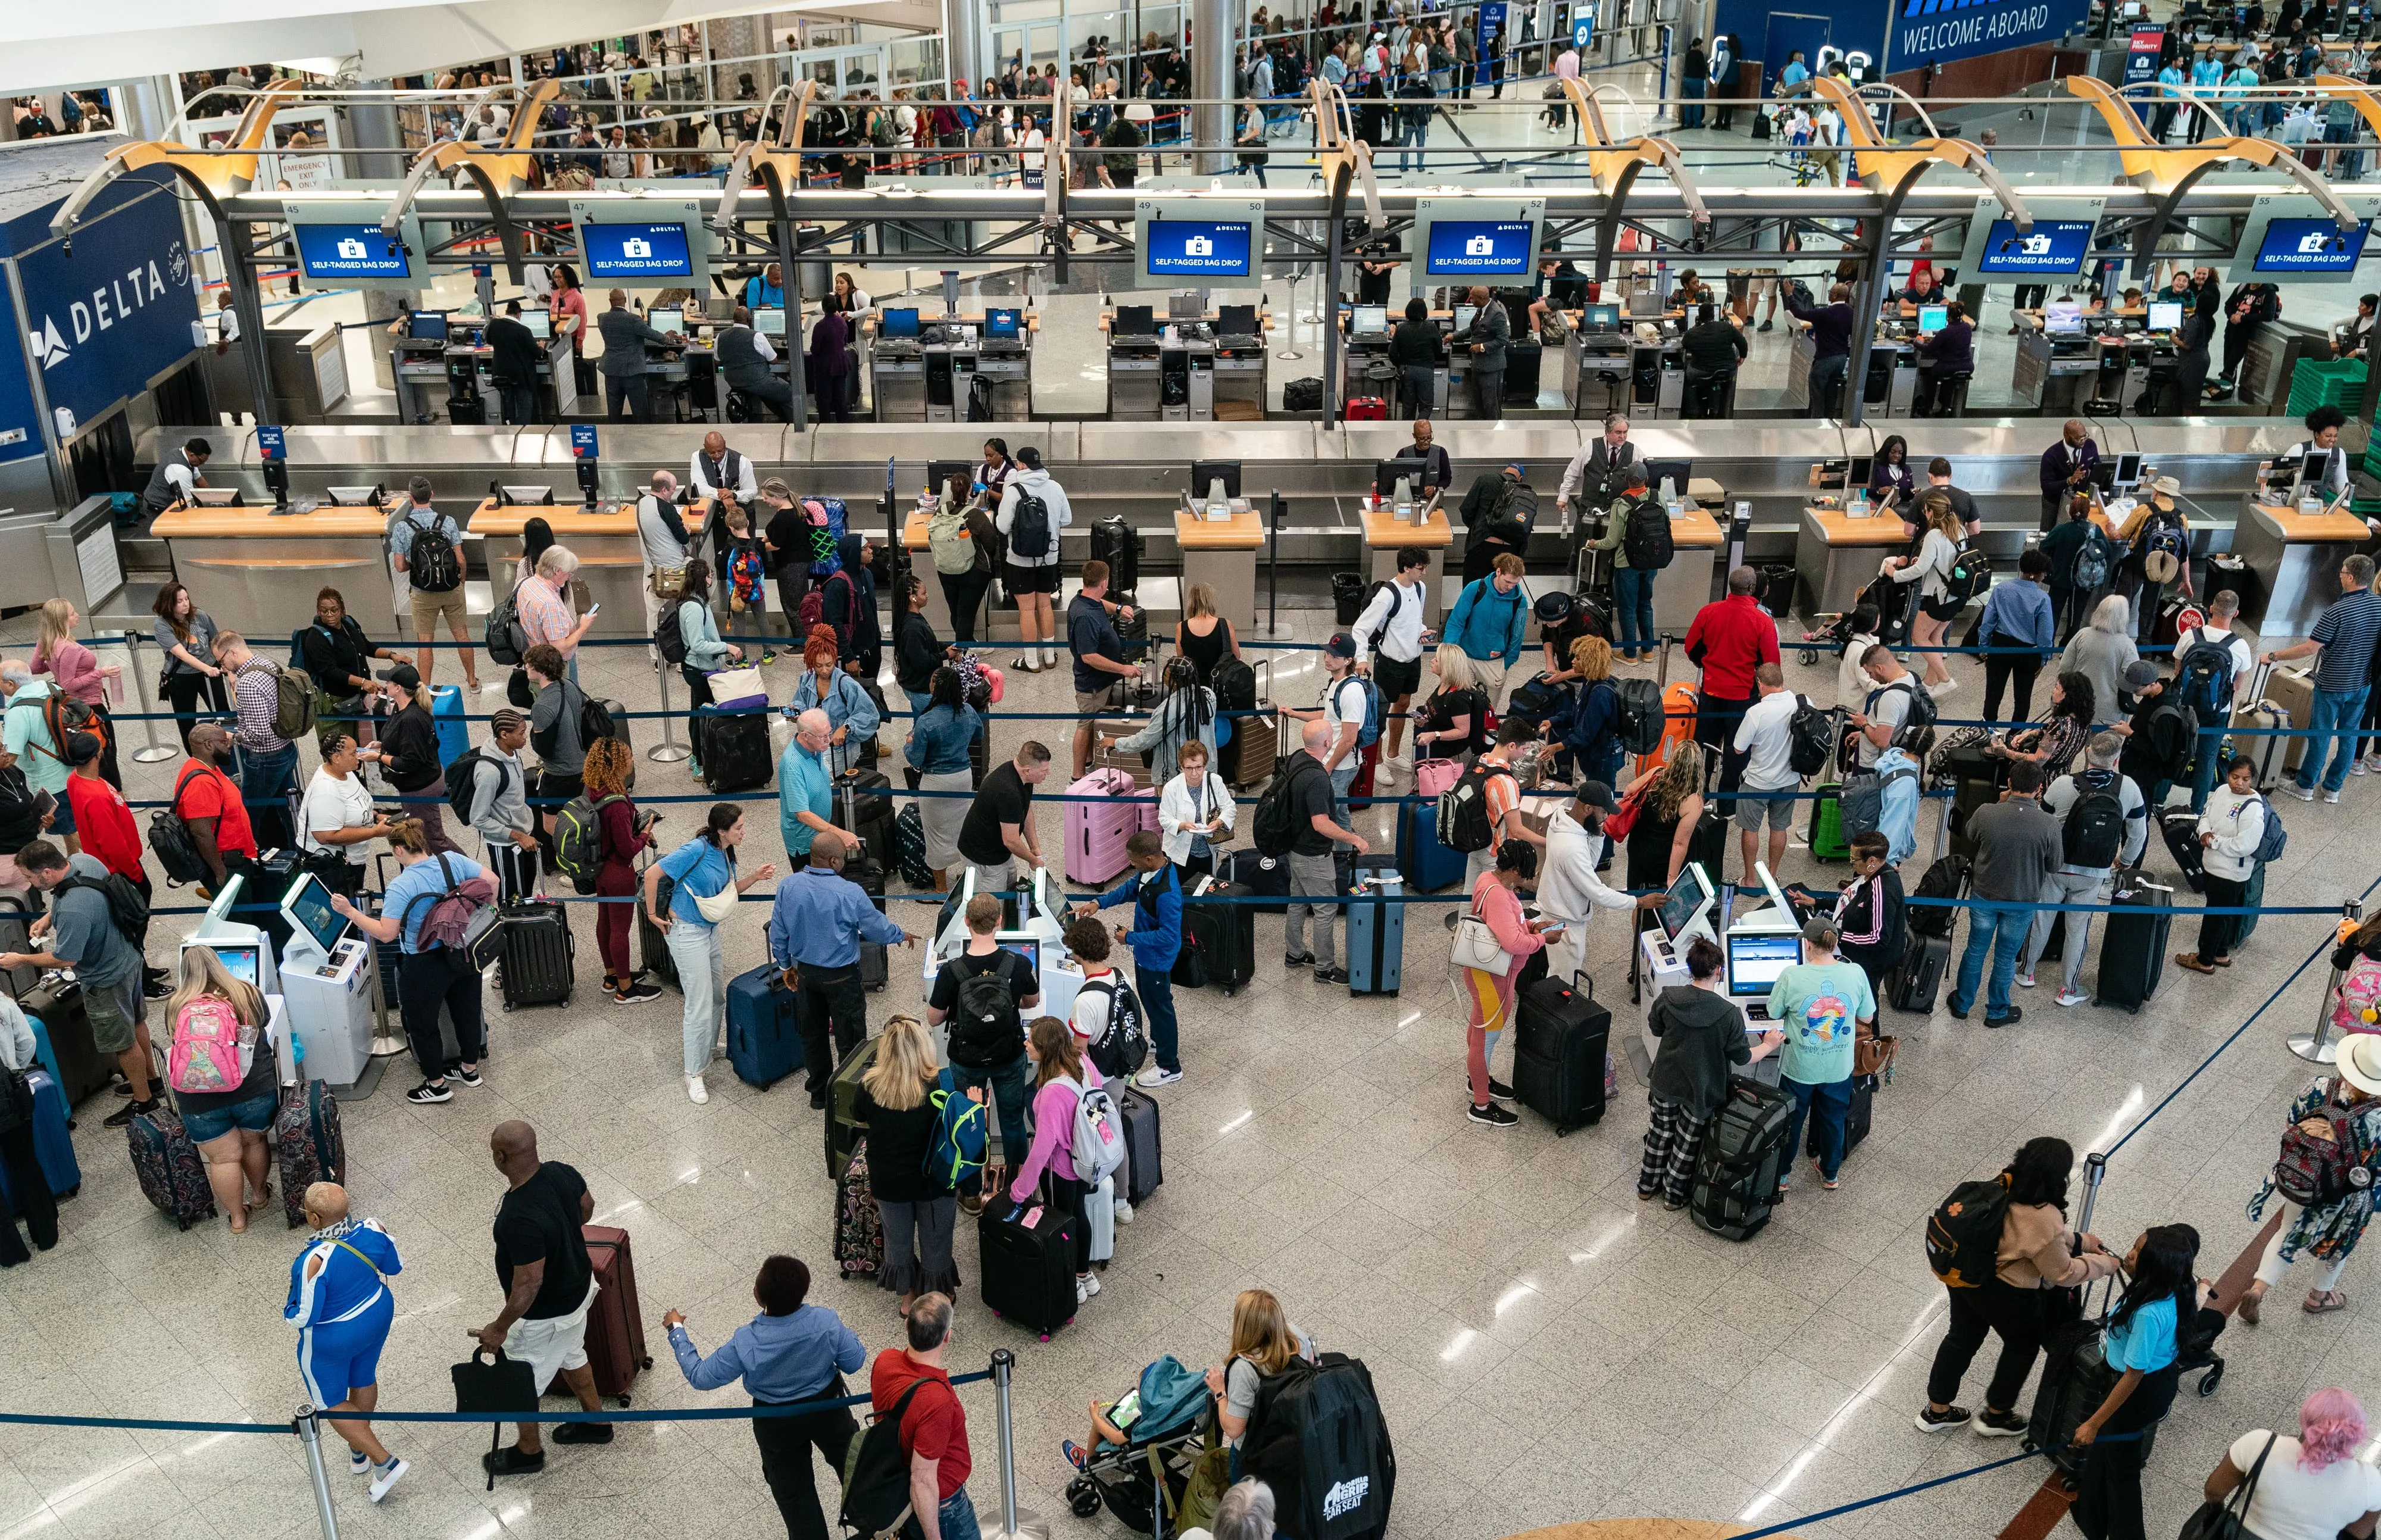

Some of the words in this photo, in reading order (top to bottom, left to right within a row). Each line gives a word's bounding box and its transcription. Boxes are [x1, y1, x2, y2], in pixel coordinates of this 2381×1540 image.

[1904, 16, 1984, 56] WELCOME
[1986, 5, 2048, 40] ABOARD
[283, 161, 326, 173] EMERGENCY
[299, 180, 317, 189] ONLY
[287, 205, 299, 214] 45
[70, 259, 166, 344] DELTA
[2181, 615, 2192, 625] WAIT
[2186, 612, 2200, 623] PLEASE
[233, 965, 243, 973] IN
[1798, 1043, 1820, 1052] simply
[1821, 1042, 1848, 1052] southern
[1341, 1476, 1368, 1490] GORILLA
[1341, 1482, 1368, 1500] GRIP
[1326, 1505, 1341, 1521] CAR
[1342, 1495, 1362, 1512] SEAT
